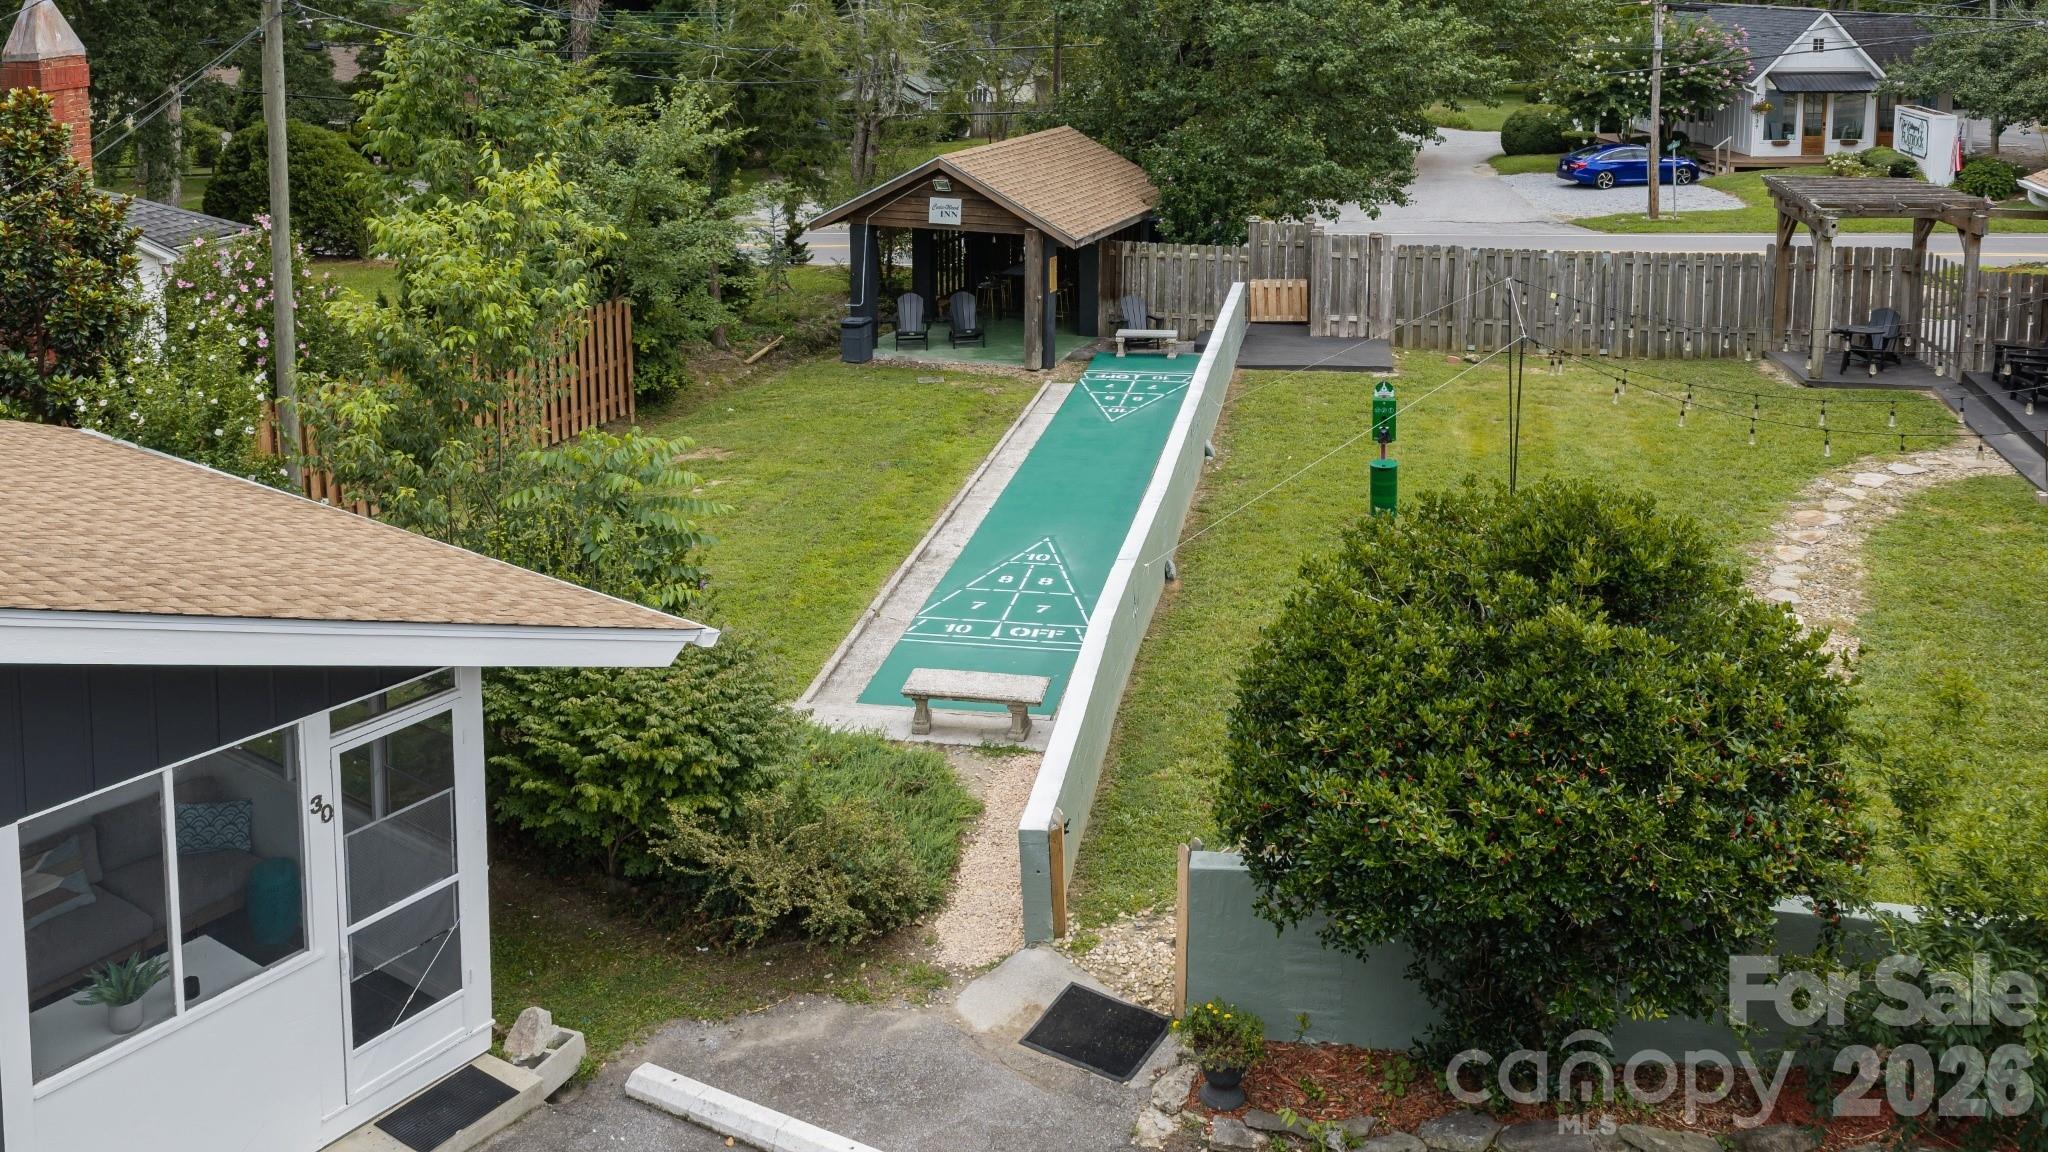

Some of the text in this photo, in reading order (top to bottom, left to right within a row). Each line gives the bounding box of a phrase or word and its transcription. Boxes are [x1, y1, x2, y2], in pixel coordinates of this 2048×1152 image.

[940, 210, 957, 218] INN
[1026, 553, 1051, 561] 10
[998, 575, 1054, 586] 8 8
[970, 601, 1052, 613] 7 7
[945, 624, 1066, 639] 10 OFF
[310, 794, 334, 823] 30
